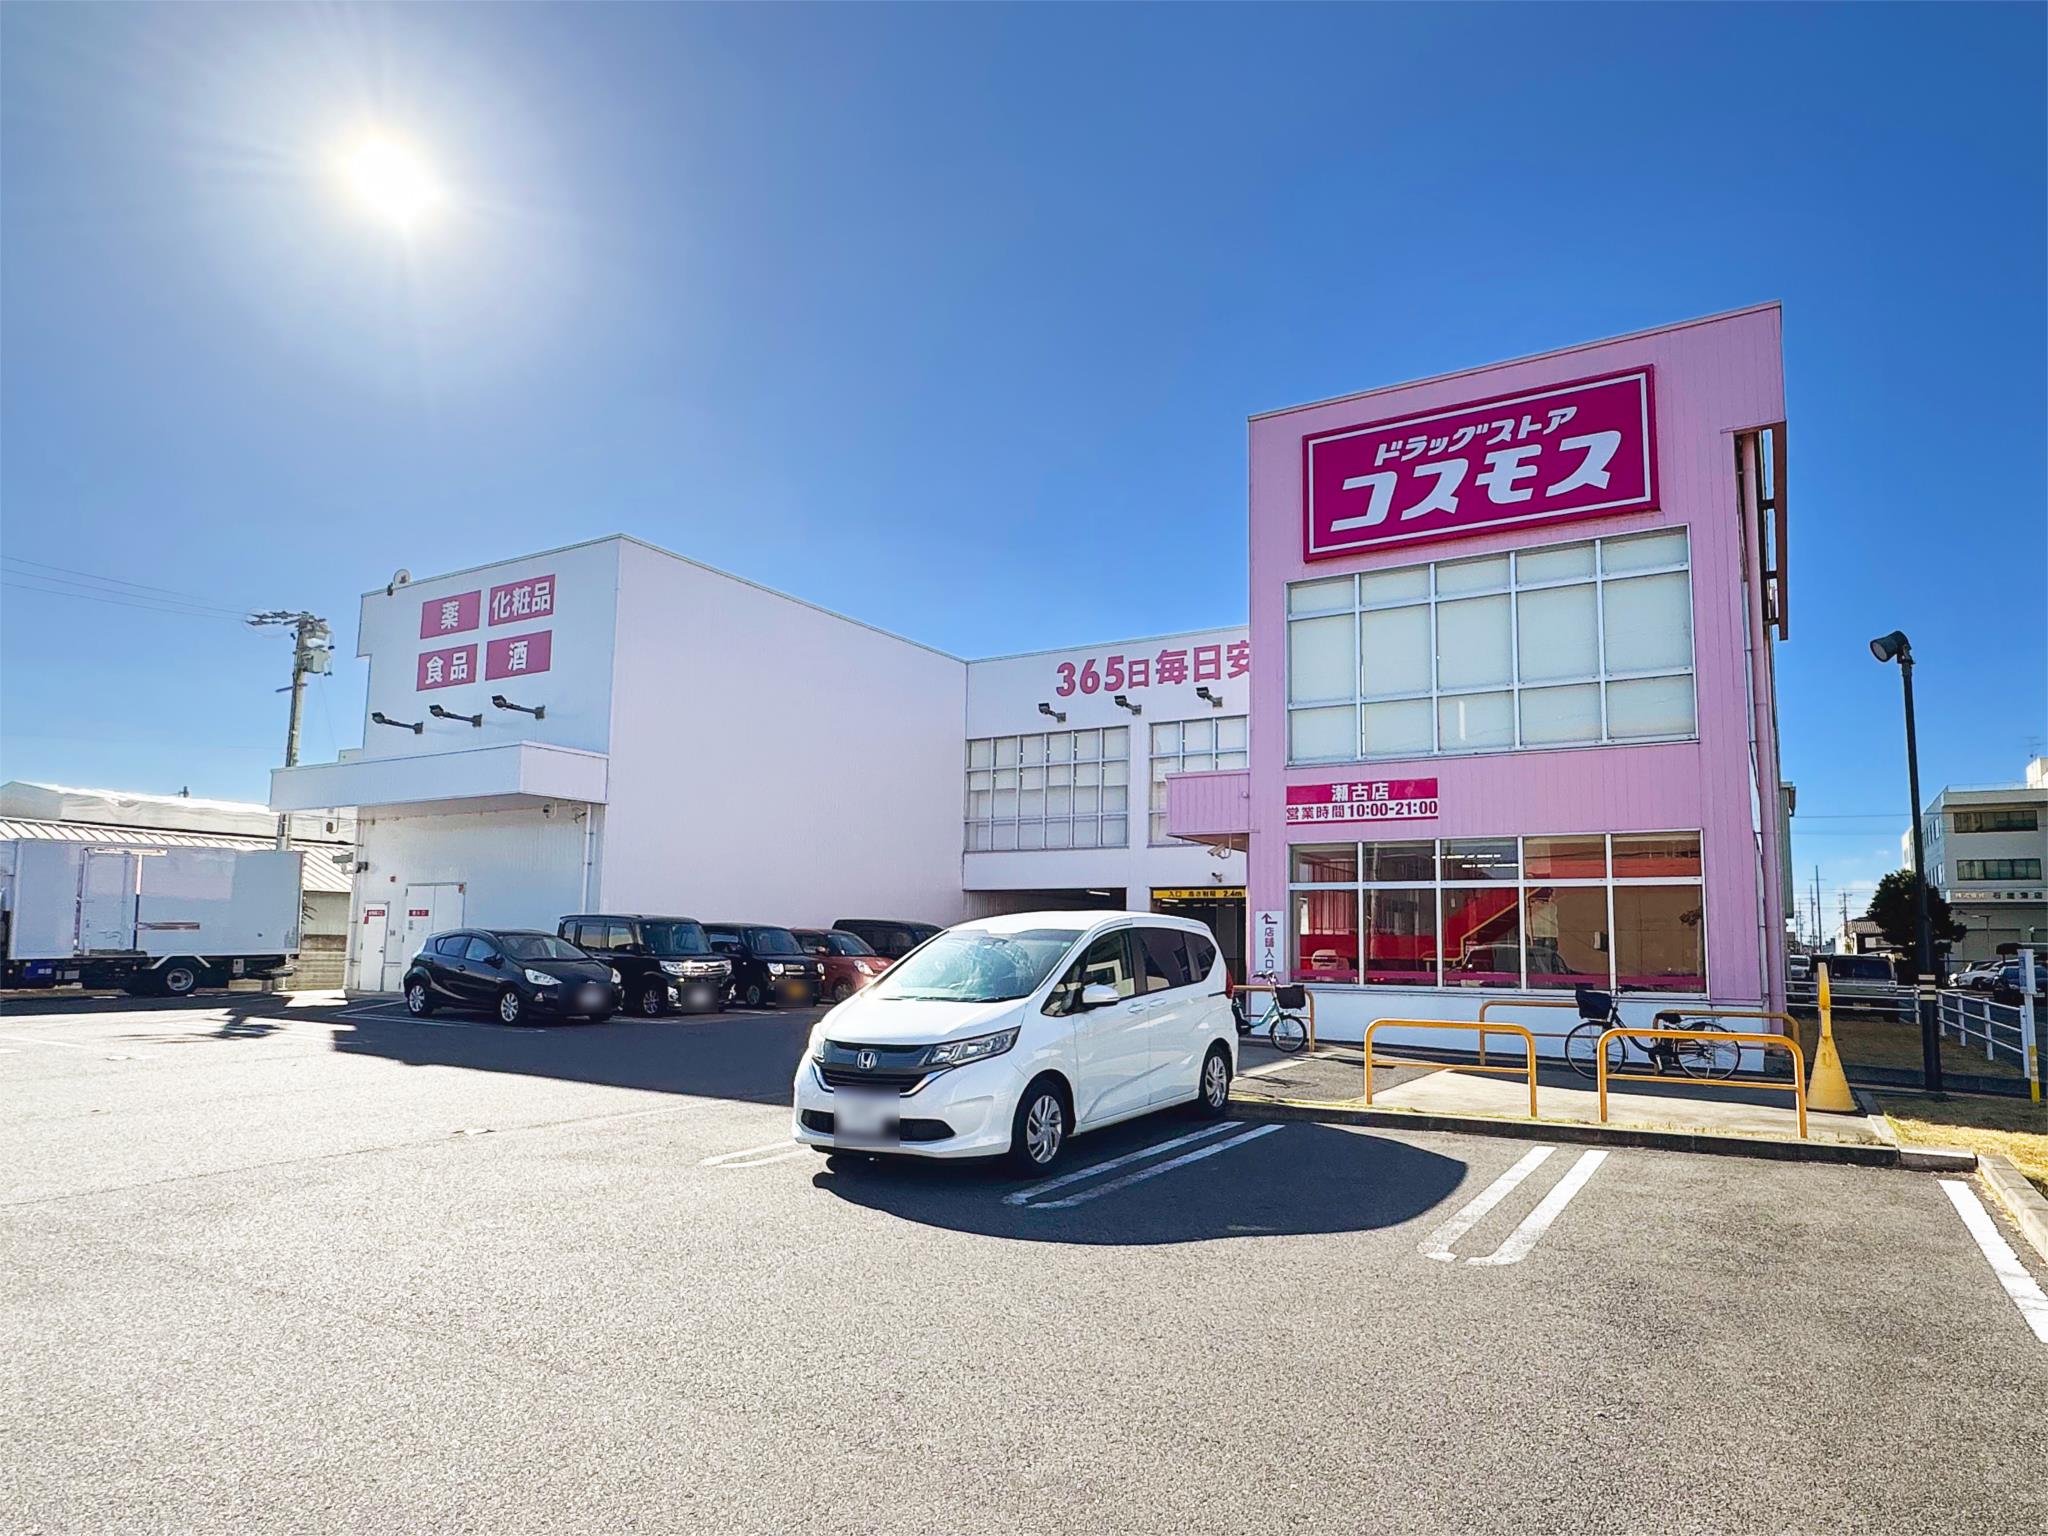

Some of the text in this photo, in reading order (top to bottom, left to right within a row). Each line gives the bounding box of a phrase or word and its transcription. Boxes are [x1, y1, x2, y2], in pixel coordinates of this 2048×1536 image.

[1374, 406, 1578, 467] ドラッグストア
[1330, 430, 1622, 533] コスモス
[440, 600, 460, 630] 薬
[492, 581, 551, 621] 化粧品
[425, 651, 468, 685] 食品
[507, 640, 529, 672] 酒
[1331, 782, 1390, 803] 瀬古店
